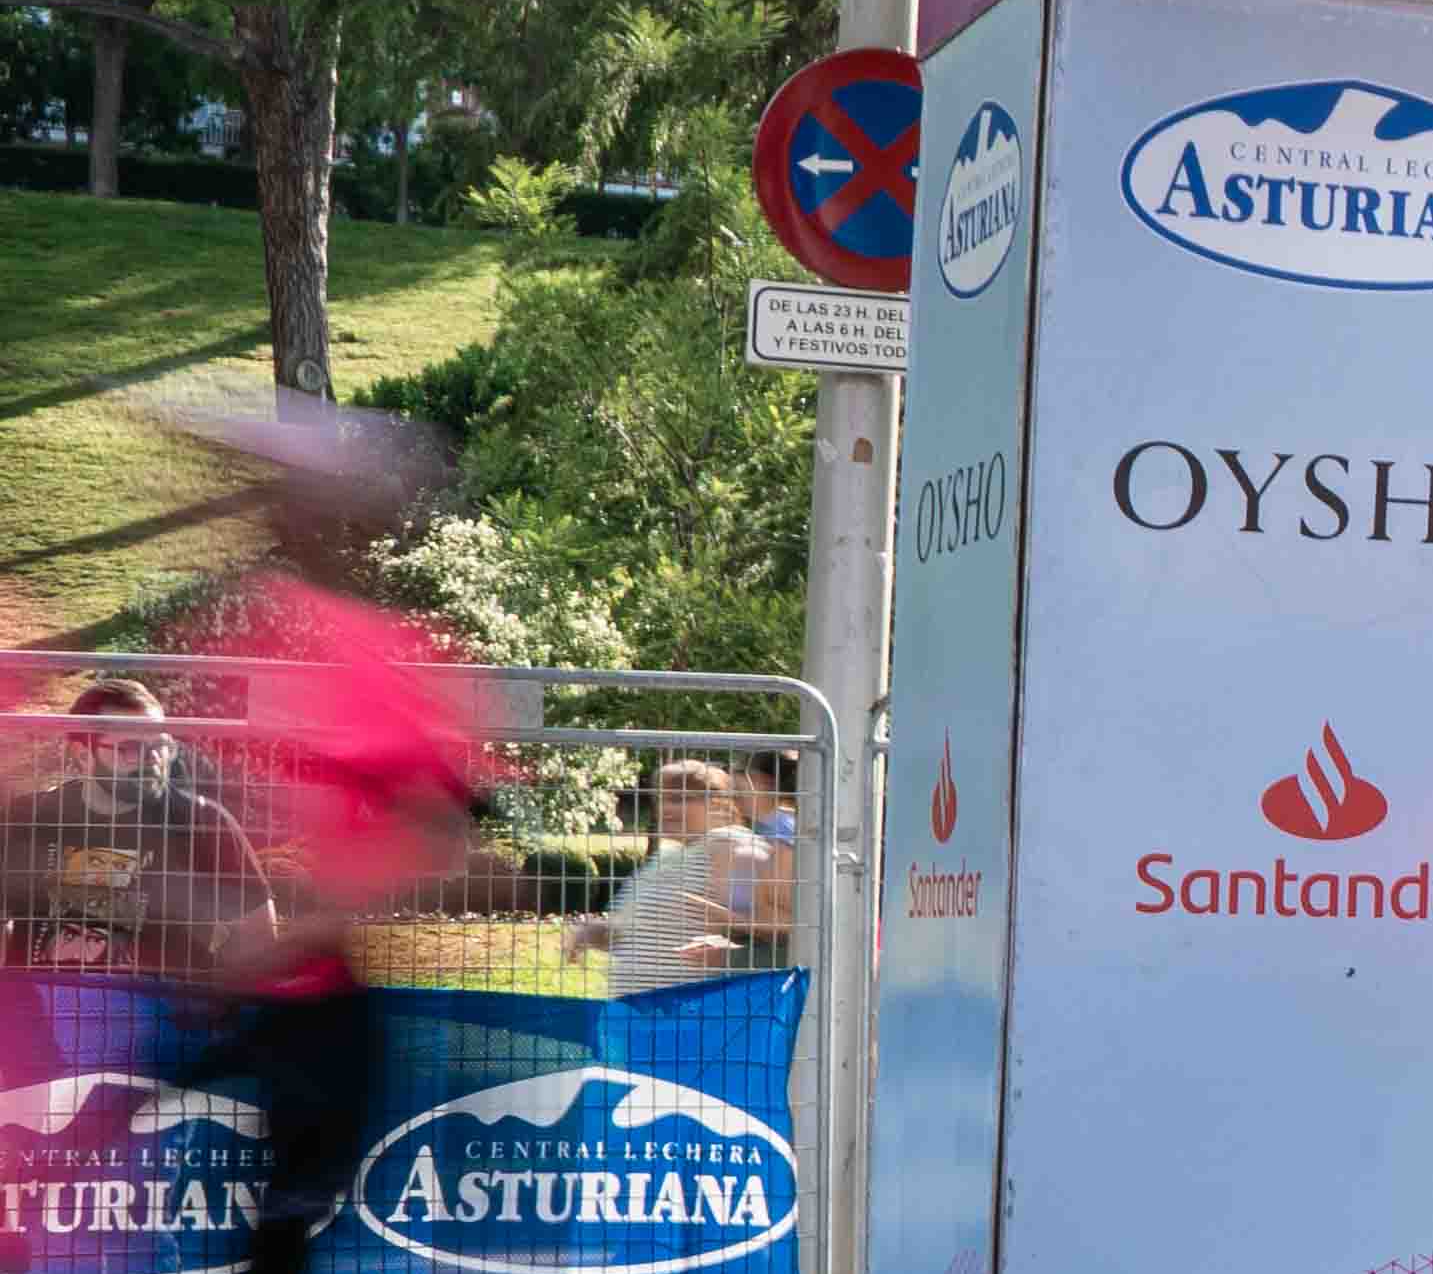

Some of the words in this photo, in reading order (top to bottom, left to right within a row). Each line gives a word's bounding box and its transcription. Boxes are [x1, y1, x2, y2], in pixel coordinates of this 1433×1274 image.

[1230, 141, 1371, 174] CENTRAL
[769, 298, 793, 312] DE
[796, 301, 829, 316] LAS
[834, 304, 851, 318] 23
[877, 309, 907, 322] DEL
[785, 319, 799, 333] A
[803, 320, 835, 335] LAS
[874, 327, 905, 341] DEL
[773, 336, 784, 351] Y
[788, 337, 869, 356] FESTIVOS
[916, 452, 1006, 564] OYSHO
[908, 854, 983, 919] Santander
[464, 1140, 607, 1160] CENTRAL
[624, 1142, 764, 1166] LECHERA
[386, 1144, 773, 1227] ASTURIANA
